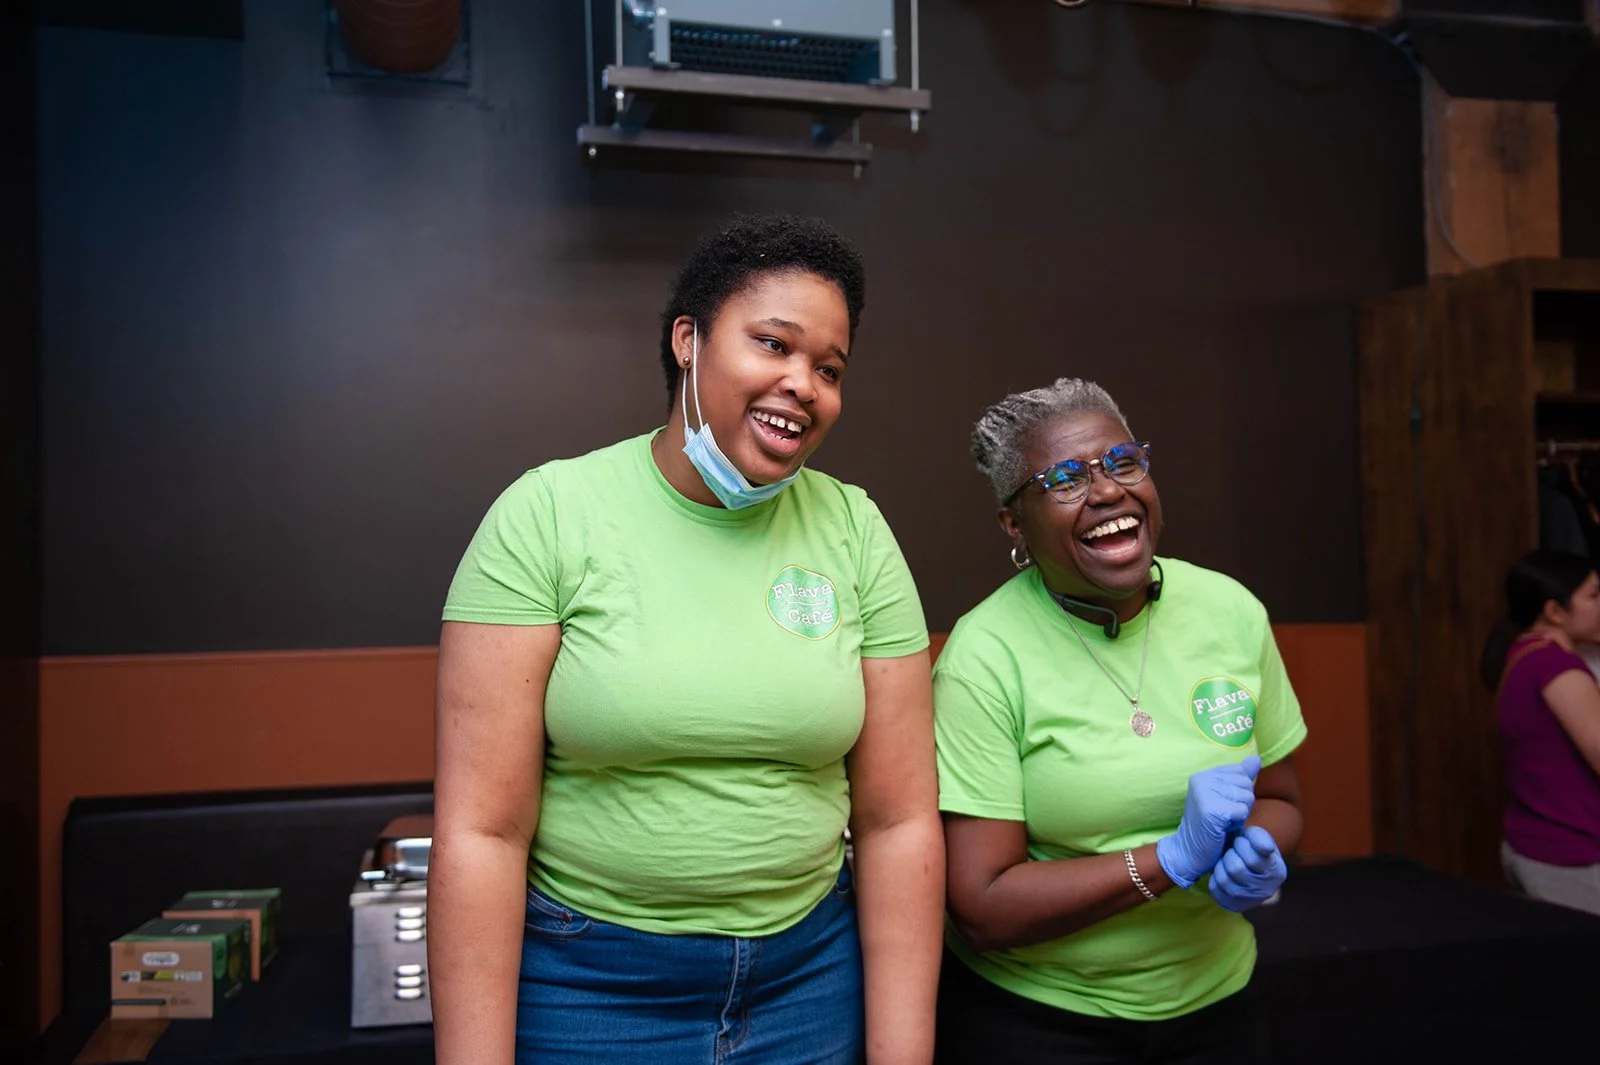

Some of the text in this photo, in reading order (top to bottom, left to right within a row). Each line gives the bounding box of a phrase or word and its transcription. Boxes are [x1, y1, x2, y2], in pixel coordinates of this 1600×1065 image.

[772, 582, 834, 600] Flava
[787, 608, 833, 625] Café
[1193, 689, 1250, 715] Flava
[1212, 713, 1254, 737] Café
